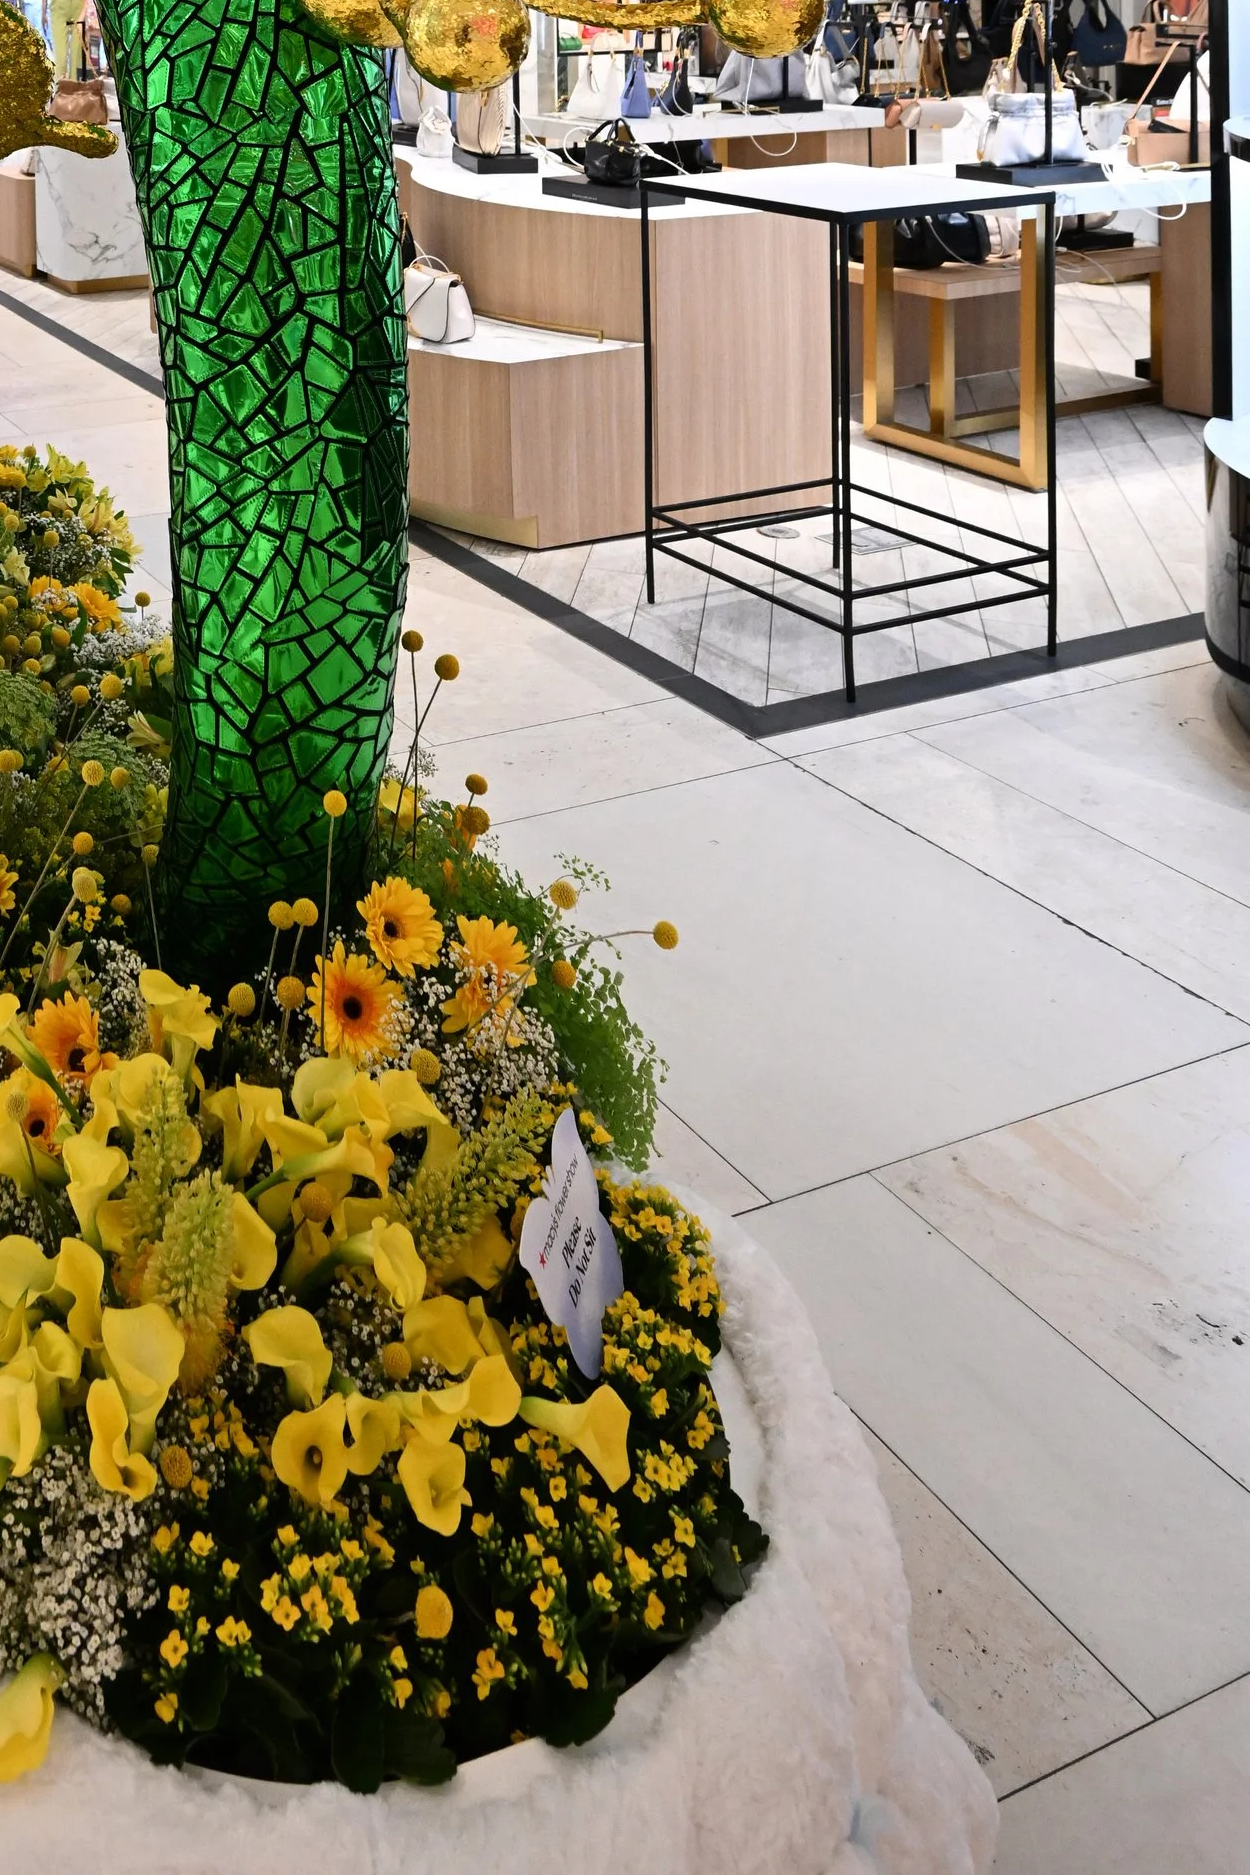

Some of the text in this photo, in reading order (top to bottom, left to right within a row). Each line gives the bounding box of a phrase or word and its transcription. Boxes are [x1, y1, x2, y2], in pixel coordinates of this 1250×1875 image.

[543, 1153, 578, 1261] macy's flower show
[561, 1216, 582, 1269] Please
[568, 1226, 597, 1310] Do Not Sit
